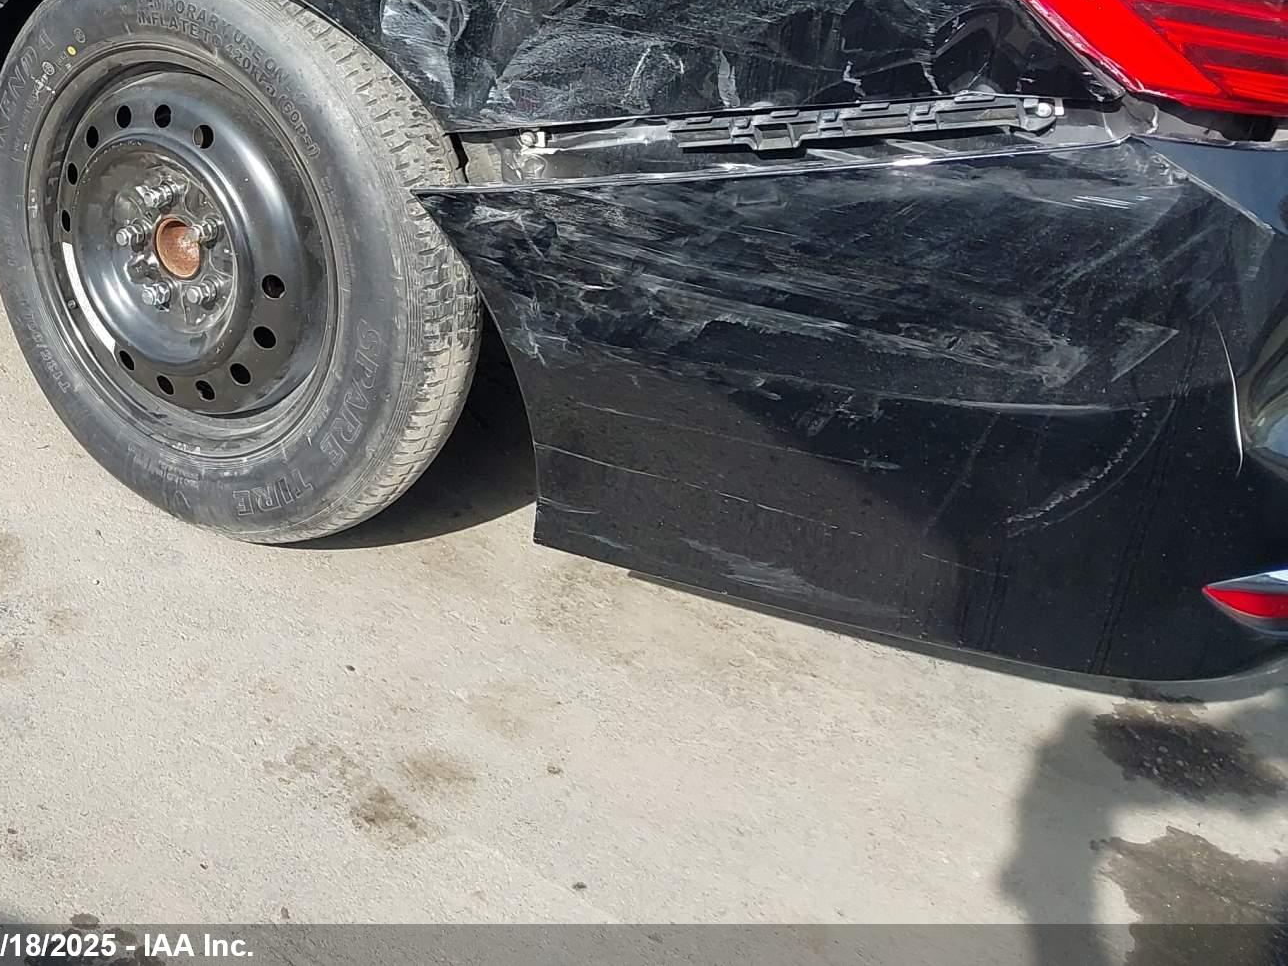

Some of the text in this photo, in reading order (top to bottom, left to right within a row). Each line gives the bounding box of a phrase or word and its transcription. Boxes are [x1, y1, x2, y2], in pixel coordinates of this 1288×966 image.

[137, 9, 200, 38] INFLATE
[201, 28, 224, 48] TO
[233, 29, 266, 62] USE
[320, 319, 383, 467] SPARE
[232, 468, 313, 516] TIRE
